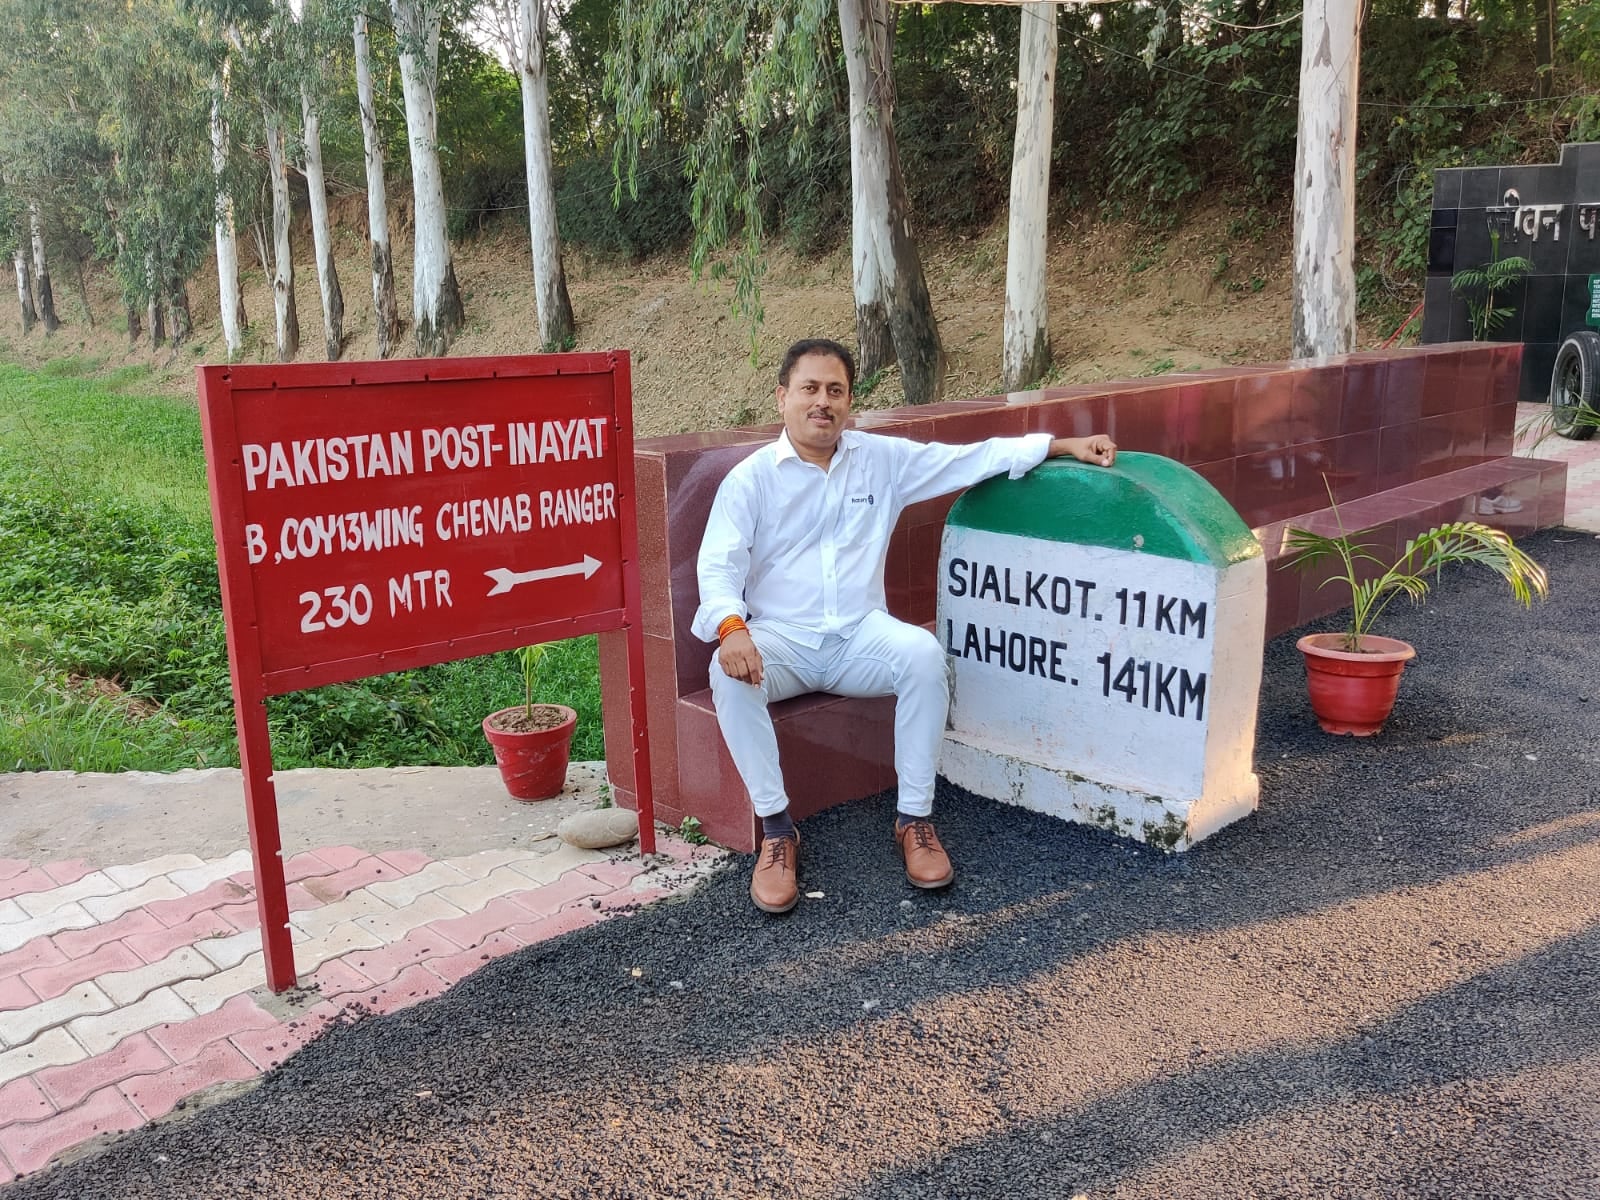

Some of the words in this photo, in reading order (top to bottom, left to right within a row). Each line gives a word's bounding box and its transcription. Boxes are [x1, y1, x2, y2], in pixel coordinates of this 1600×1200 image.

[242, 431, 414, 490] PAKISTAN
[507, 417, 607, 466] INAYAT
[436, 494, 533, 541] CHENAB
[540, 483, 616, 529] RANGER
[299, 583, 373, 634] 230
[388, 569, 453, 618] MTR
[948, 558, 1103, 621] SIALKOT.
[946, 618, 1079, 686] LAHORE.
